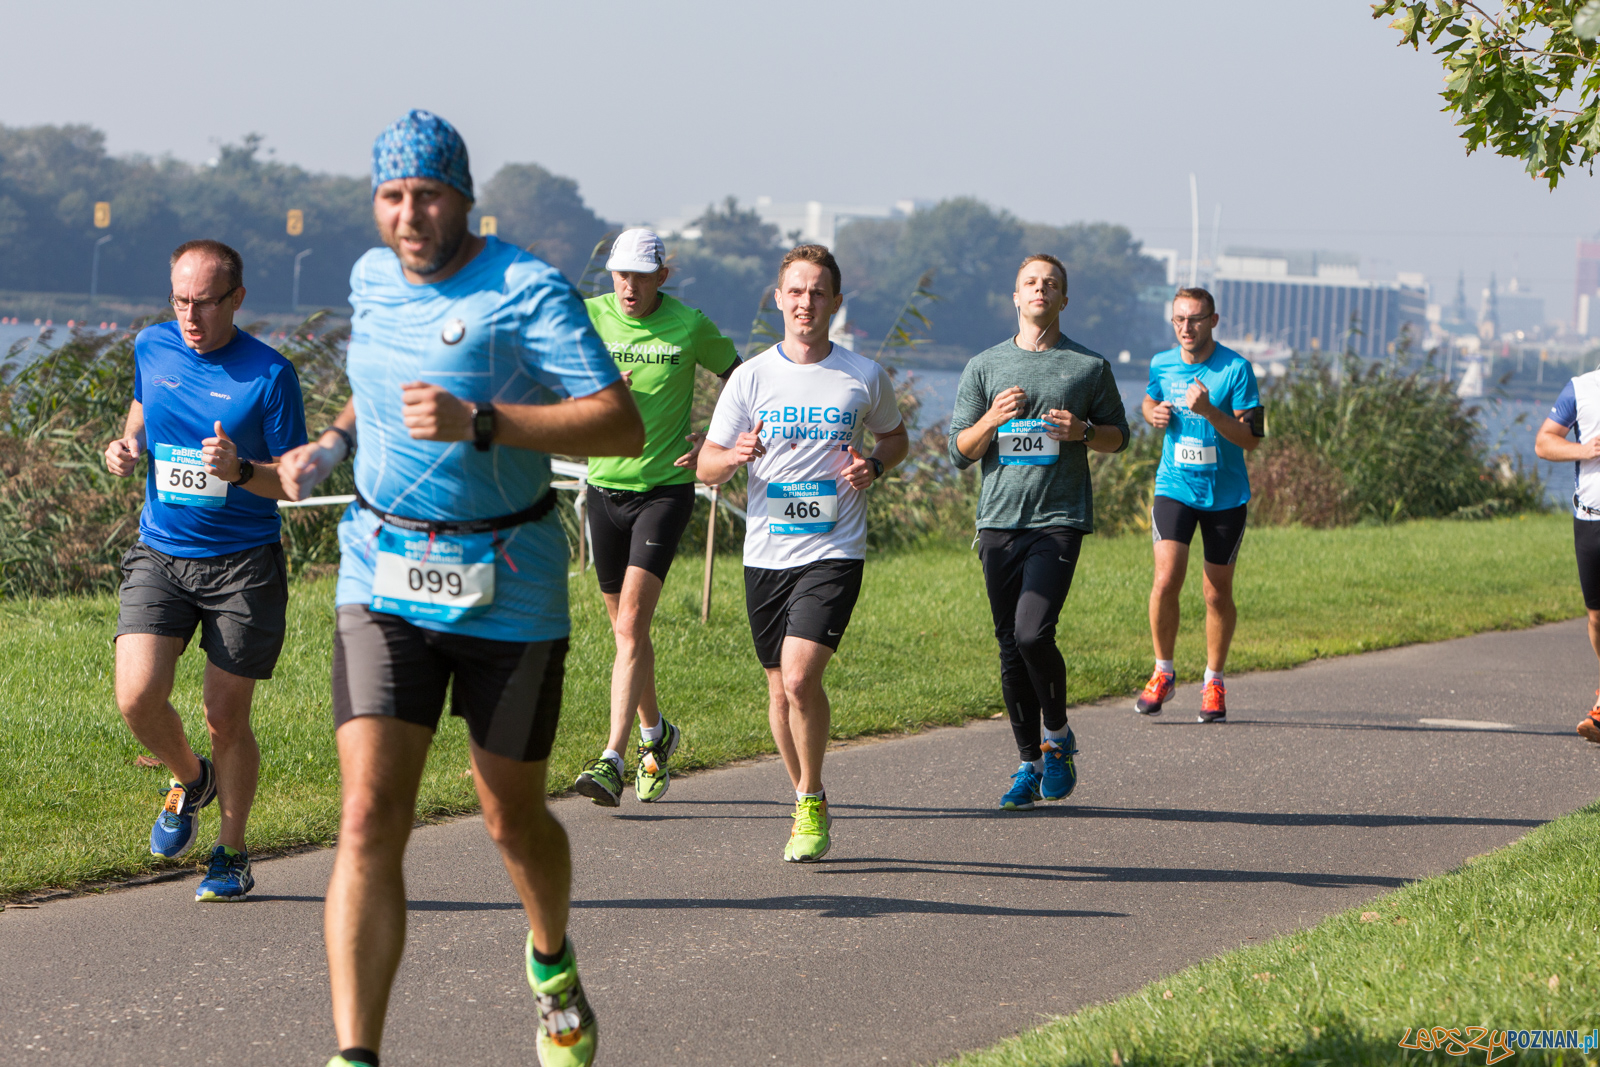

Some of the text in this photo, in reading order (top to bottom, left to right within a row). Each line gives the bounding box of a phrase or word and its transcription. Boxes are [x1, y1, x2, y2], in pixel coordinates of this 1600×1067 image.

[609, 351, 680, 365] RBALIFE
[758, 406, 858, 430] zaBIEGaj
[772, 426, 853, 441] FUNdusze
[1012, 436, 1044, 452] 204
[171, 448, 204, 459] zaBIEG
[1181, 448, 1203, 461] 031
[169, 468, 207, 490] 563
[782, 483, 819, 492] zaBIEGaj
[784, 501, 821, 519] 466
[408, 568, 463, 596] 099
[169, 793, 180, 811] 563
